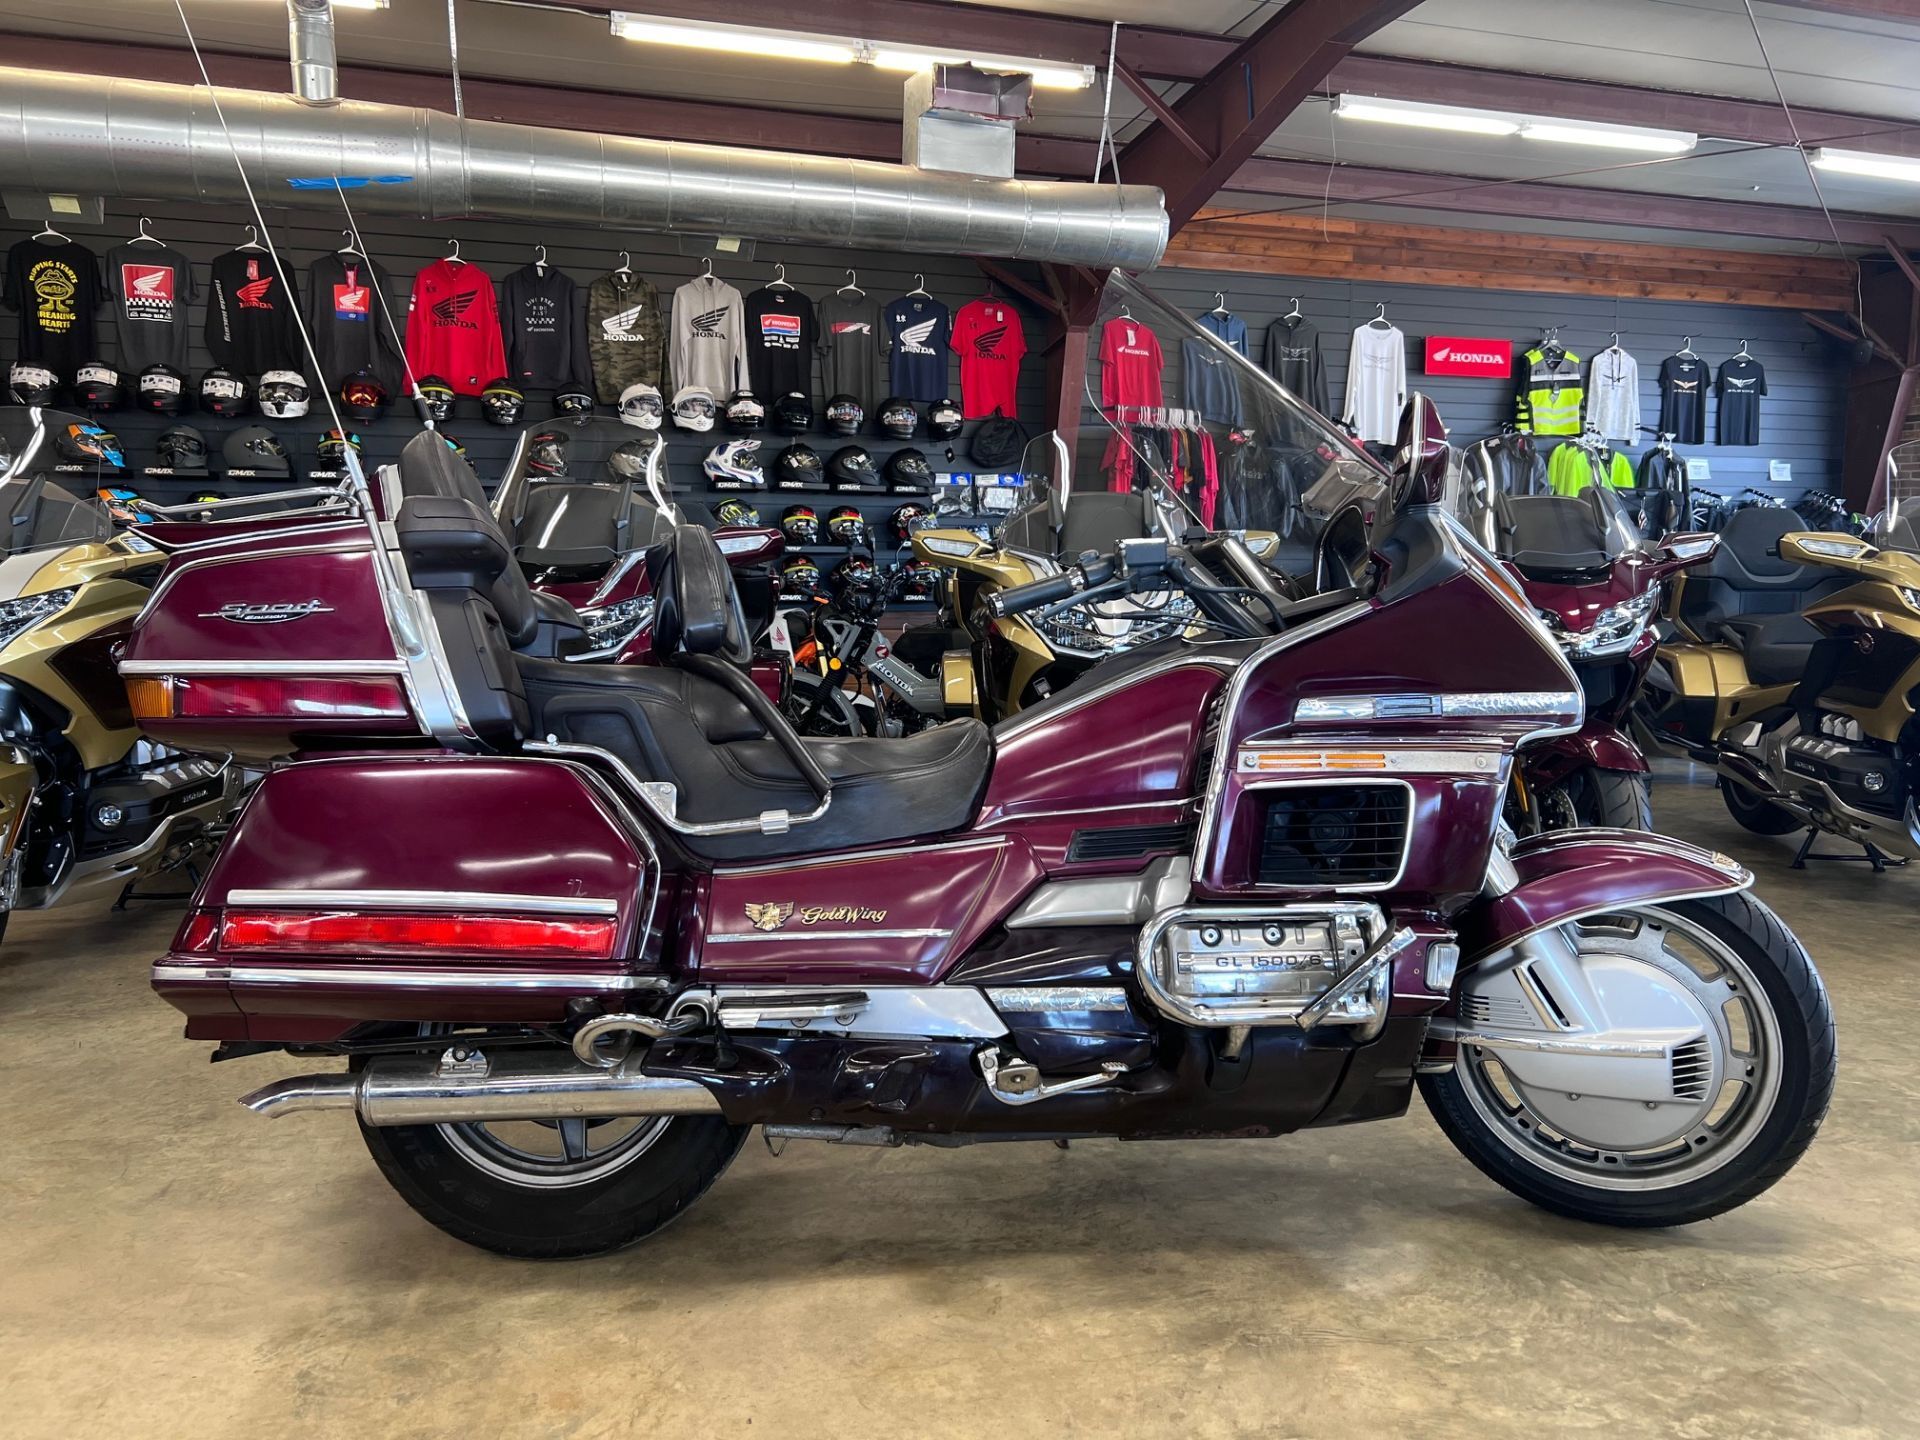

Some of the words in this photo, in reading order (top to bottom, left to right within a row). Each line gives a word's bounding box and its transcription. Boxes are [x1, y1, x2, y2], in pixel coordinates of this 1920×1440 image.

[29, 260, 54, 281] RIPPING
[55, 261, 78, 283] STARTS
[133, 289, 168, 297] HONDA
[239, 301, 273, 309] HONDA
[540, 297, 555, 308] FREE
[39, 318, 70, 328] HEARTS
[433, 319, 478, 329] HONDA
[772, 320, 797, 328] HONDA
[603, 333, 645, 341] HONDA
[692, 331, 726, 340] HONDA
[900, 346, 936, 355] HONDA
[1125, 348, 1149, 356] HONDA
[1449, 352, 1504, 364] HONDA
[144, 467, 173, 475] GMAX
[227, 469, 256, 477] GMAX
[876, 661, 914, 697] HONDA
[1215, 956, 1243, 967] GL
[1250, 954, 1322, 966] 1500/6
